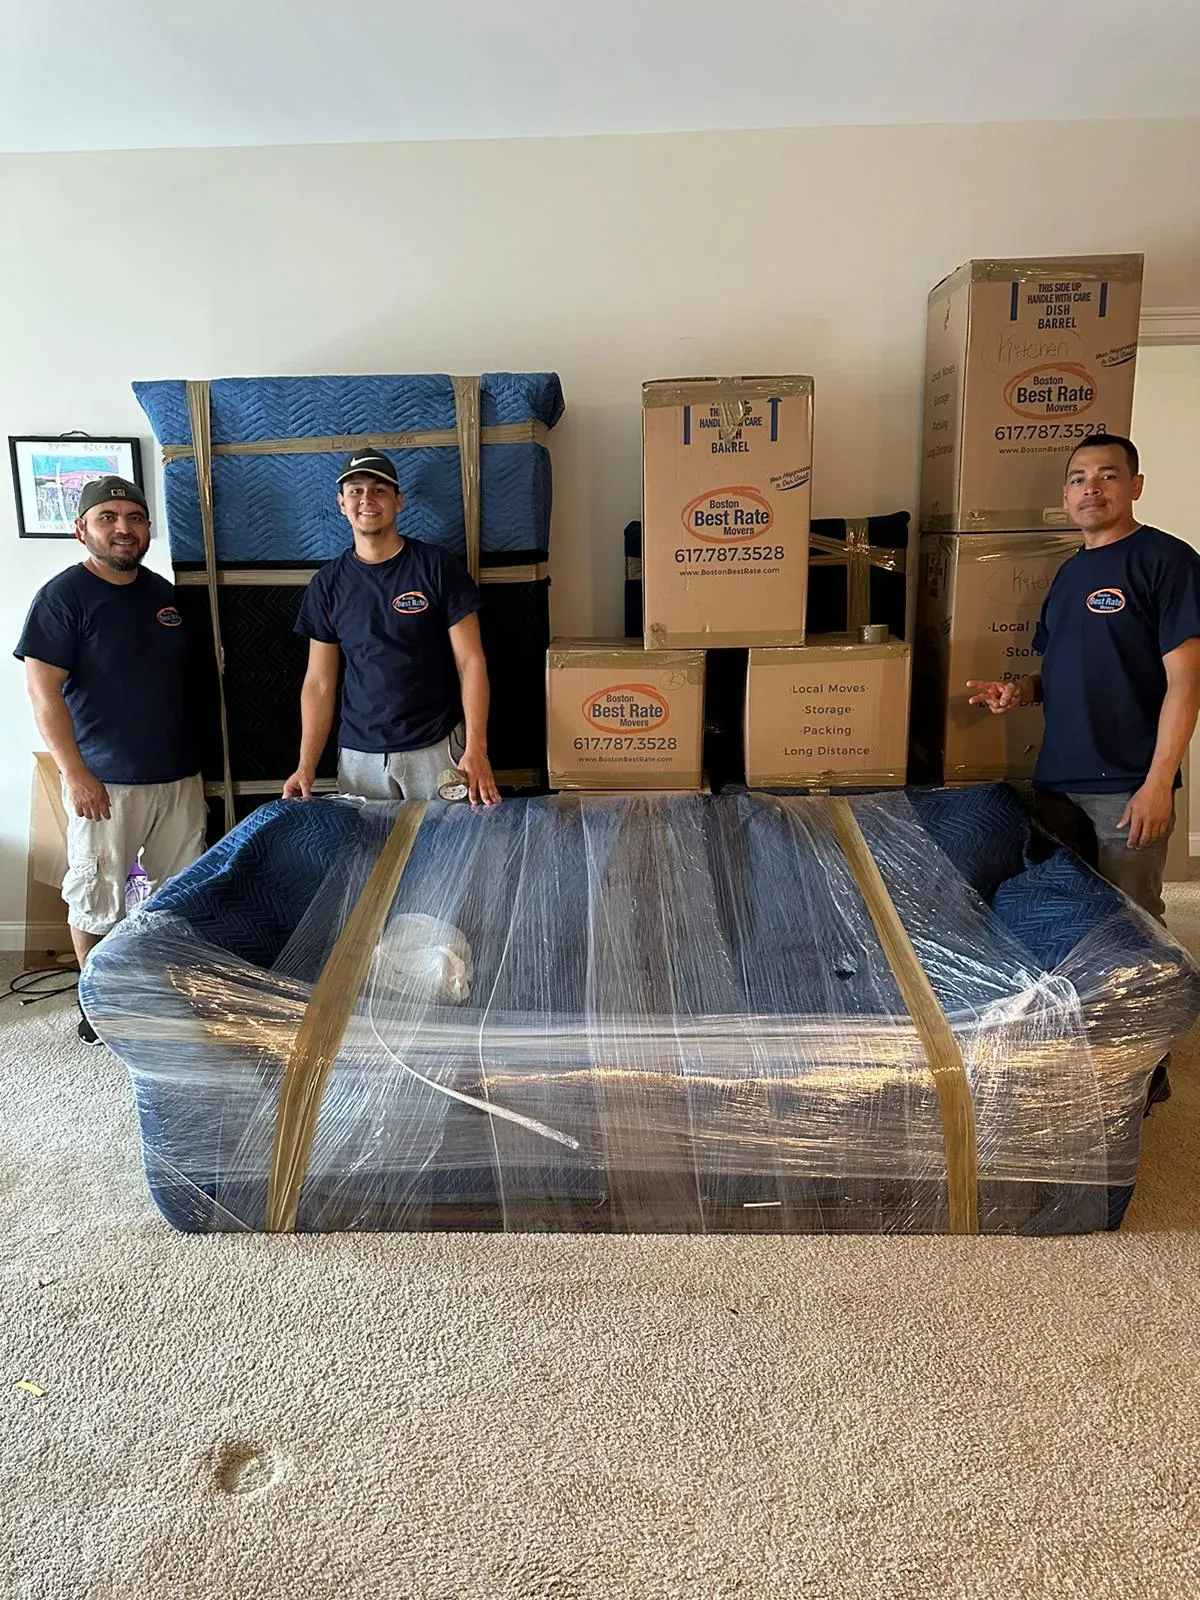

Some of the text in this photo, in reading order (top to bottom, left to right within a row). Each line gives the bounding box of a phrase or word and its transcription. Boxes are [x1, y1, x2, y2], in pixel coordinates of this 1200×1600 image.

[1038, 282, 1082, 293] THIS SIDE UP
[1027, 292, 1092, 304] HANDLE WITH CARE
[1046, 304, 1070, 316] DISH
[1038, 317, 1077, 329] BARREL
[1033, 376, 1063, 386] Boston
[1016, 385, 1094, 403] Best Rate
[1046, 403, 1078, 413] Movers
[744, 416, 763, 427] CARE
[998, 445, 1077, 454] www.BostonBestRa
[709, 500, 739, 509] Boston
[694, 509, 769, 526] Best Rate
[723, 526, 755, 536] Movers
[674, 546, 785, 564] 617.787.3528
[679, 567, 780, 577] www.BostonBestRate.com
[1005, 647, 1043, 658] Stor
[606, 694, 634, 703] Boston
[592, 703, 663, 718] Best Rate
[619, 719, 649, 728] Movers
[573, 737, 678, 751] 617.787.3528
